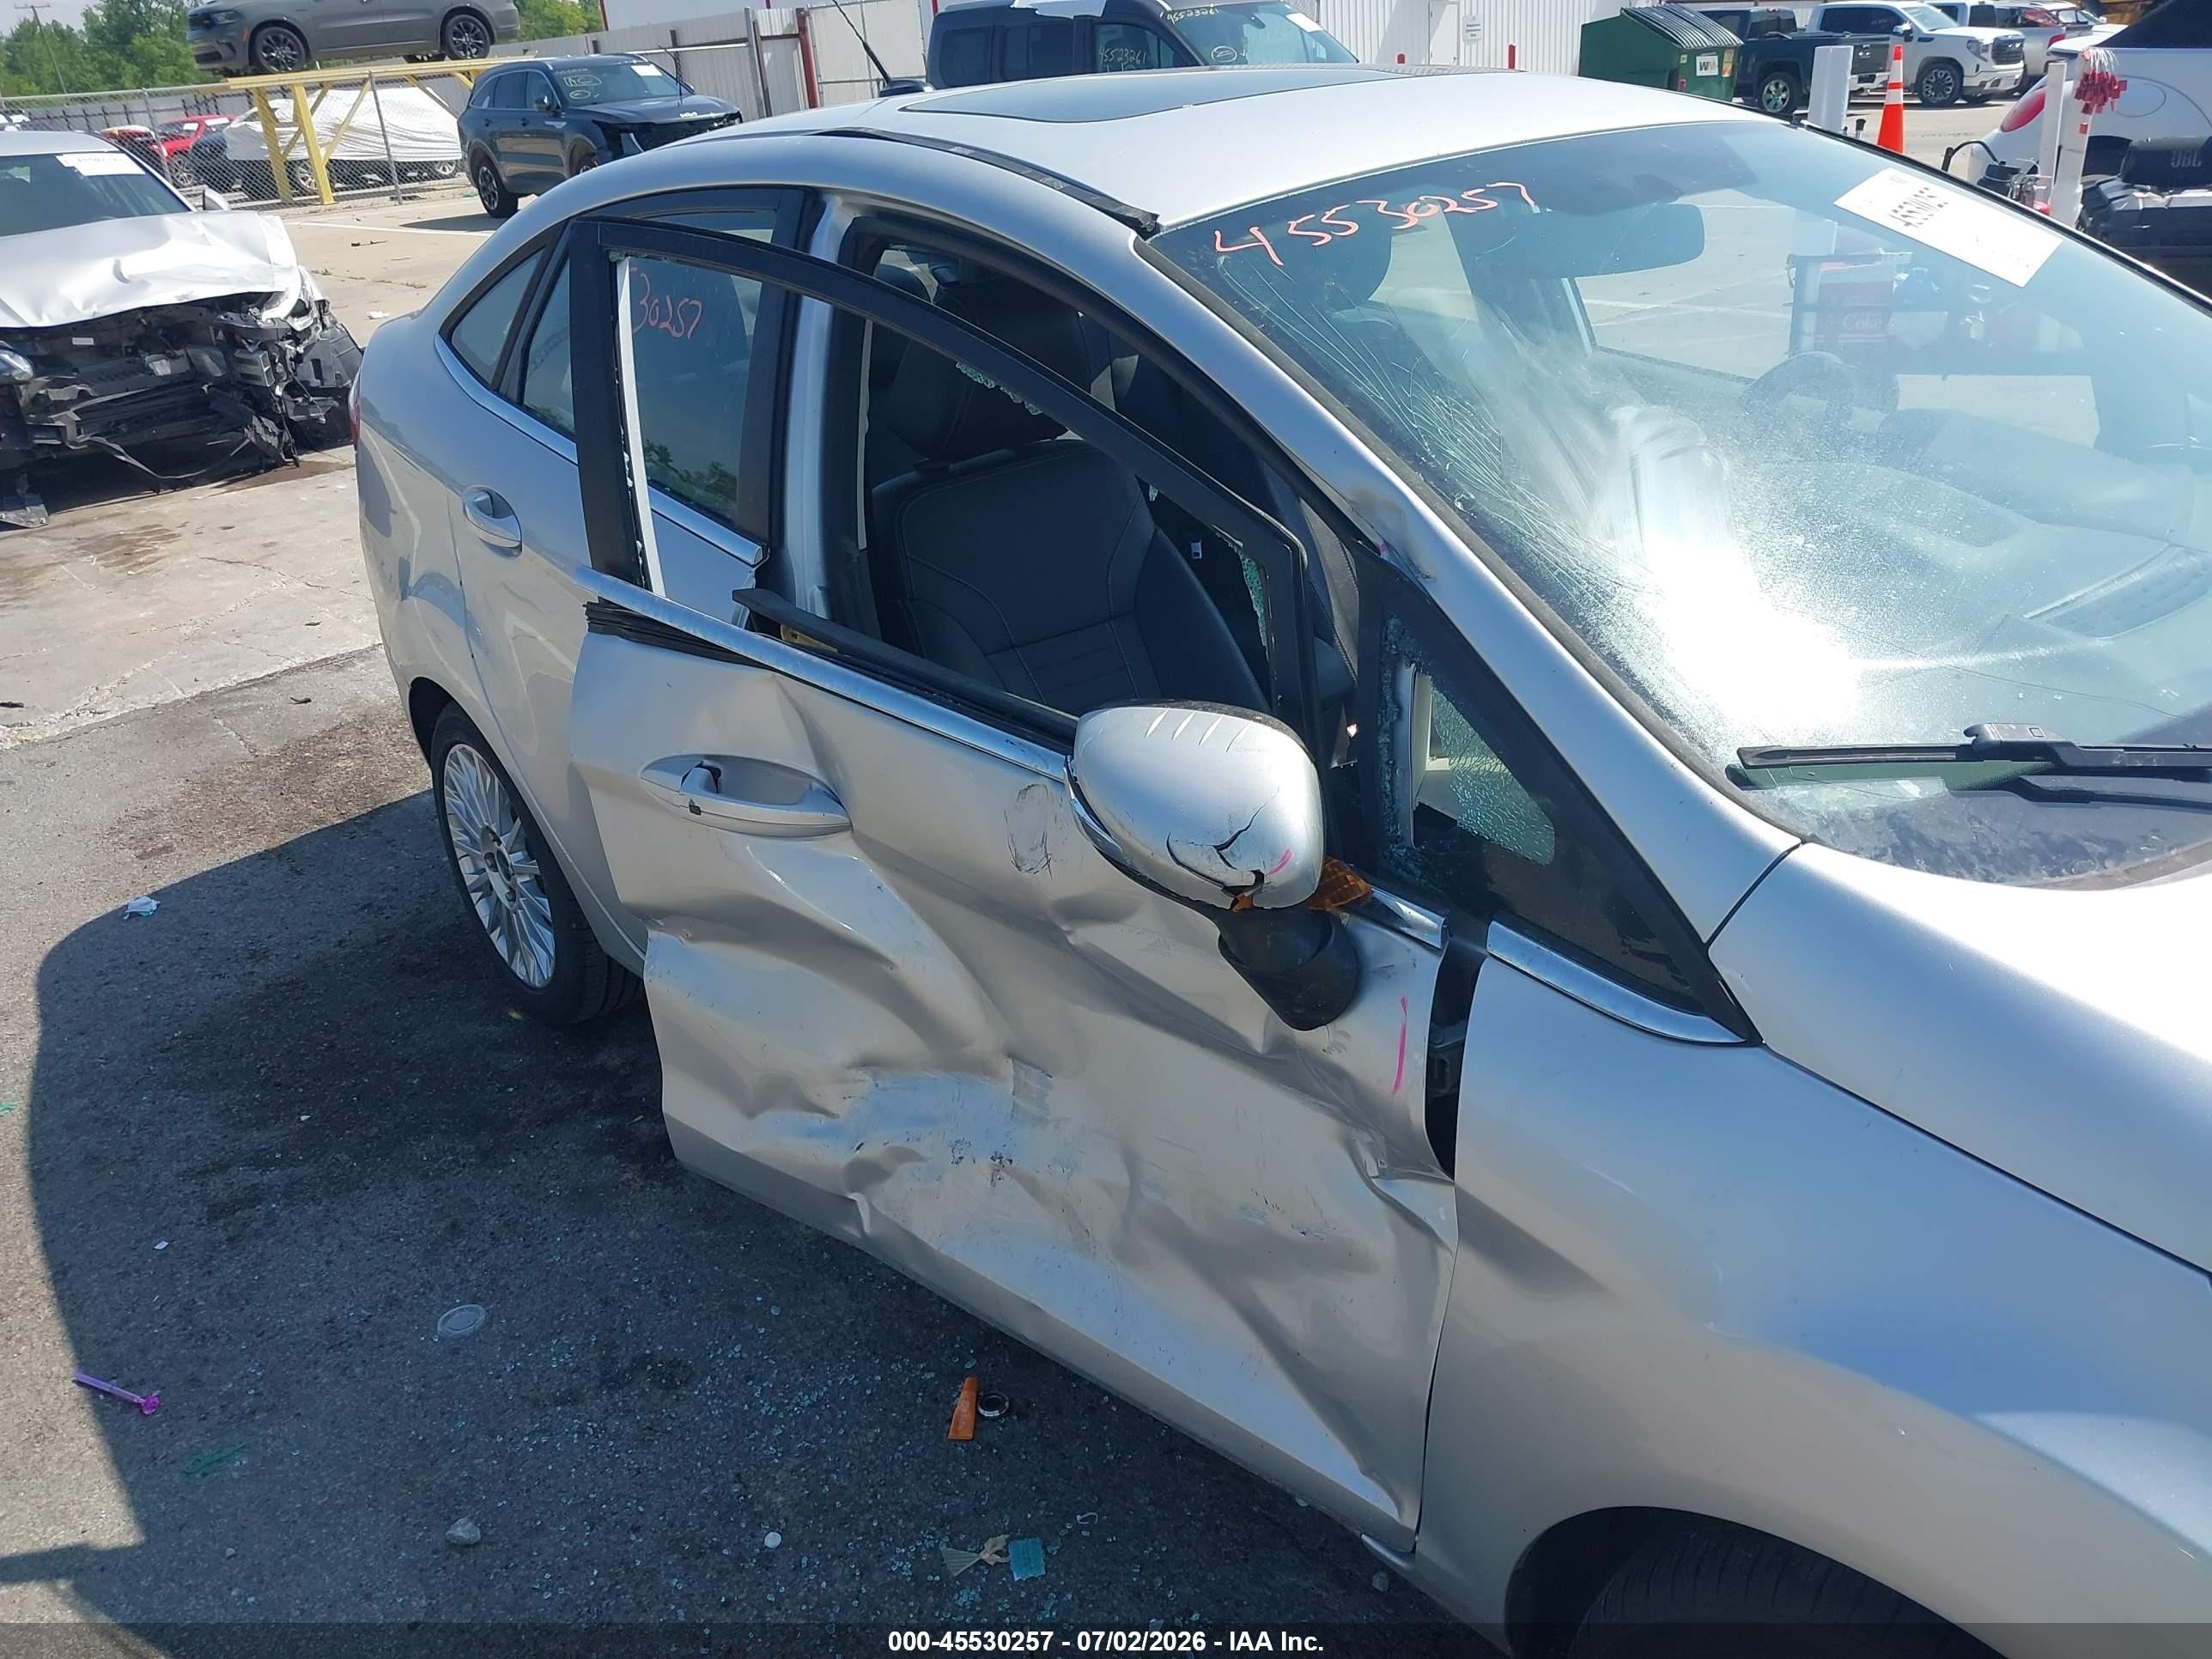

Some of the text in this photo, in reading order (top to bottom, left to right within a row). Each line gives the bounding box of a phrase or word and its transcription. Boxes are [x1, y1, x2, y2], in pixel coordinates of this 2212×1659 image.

[1099, 45, 1146, 65] 45523261
[1699, 61, 1717, 71] WM
[2171, 149, 2202, 167] JBL
[1214, 181, 1541, 266] 45530257
[630, 266, 702, 339] 30257
